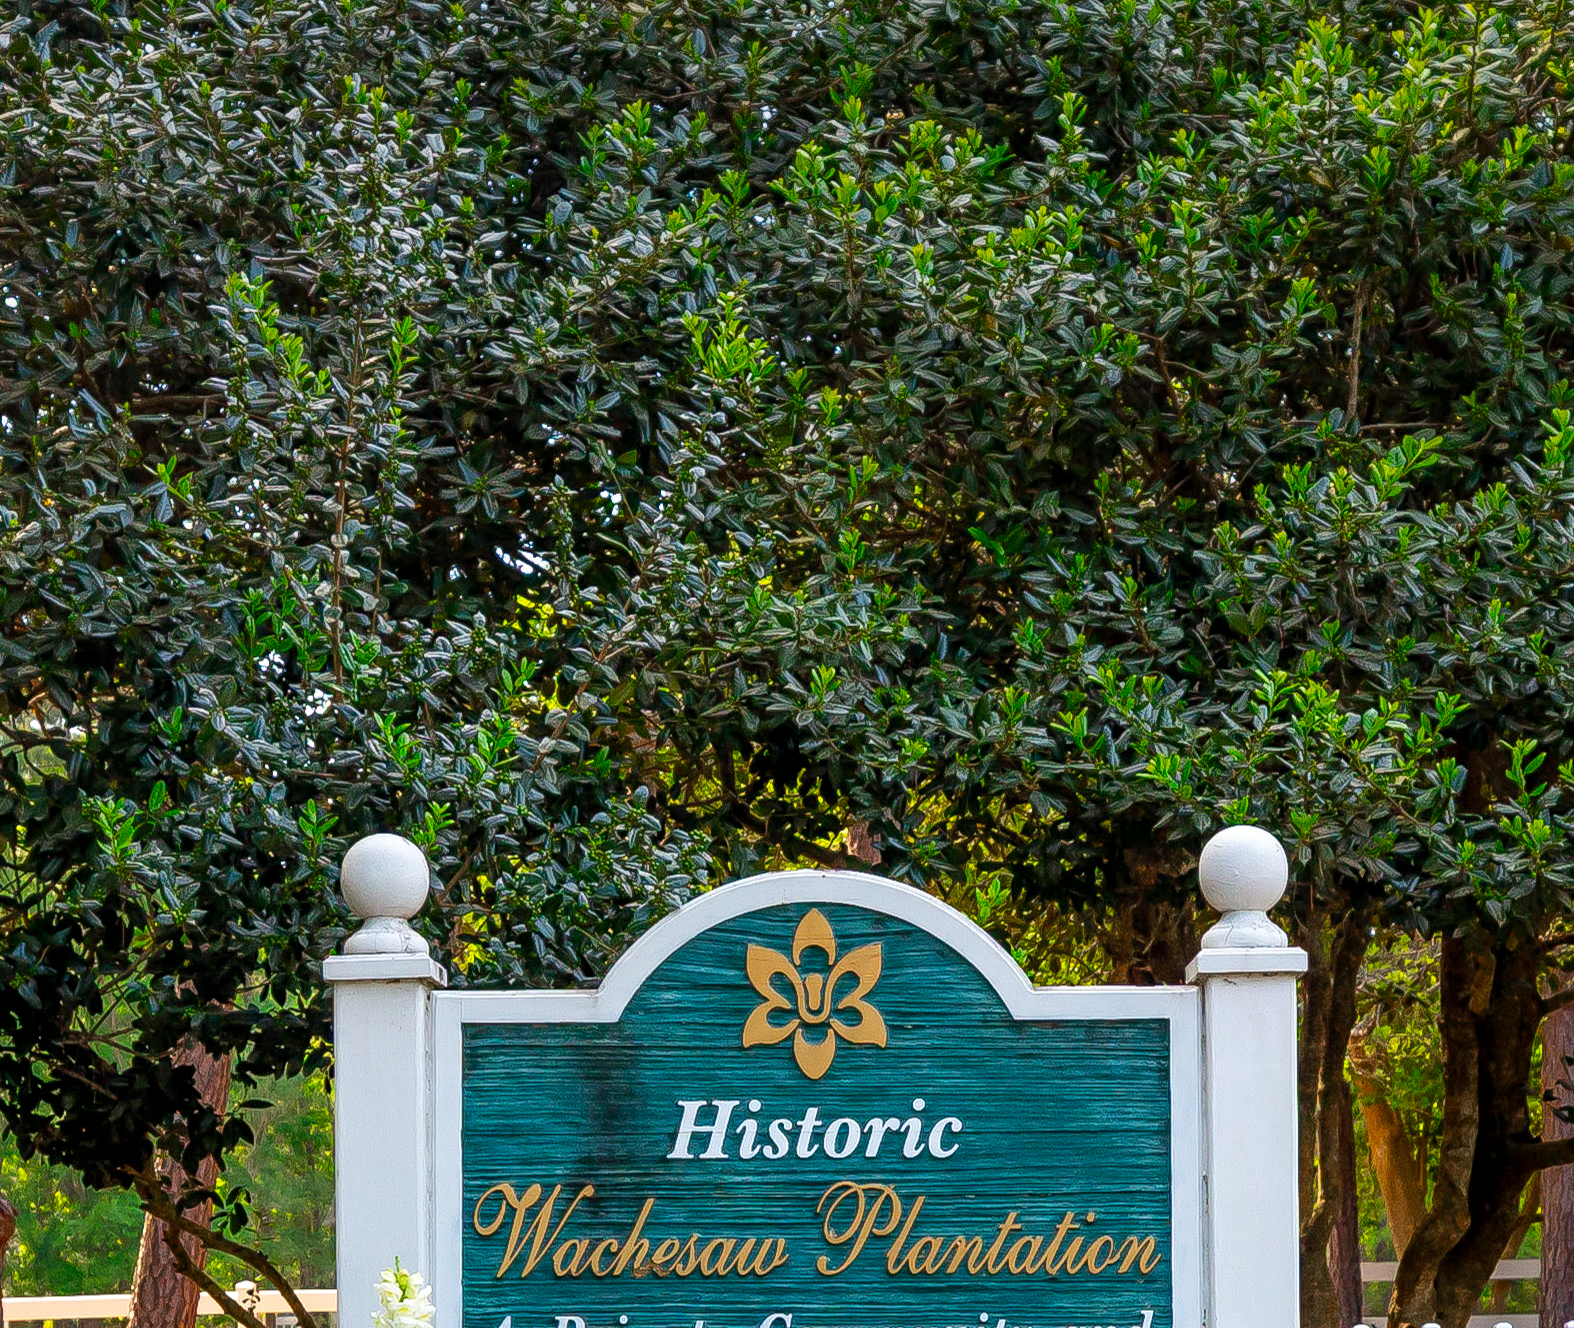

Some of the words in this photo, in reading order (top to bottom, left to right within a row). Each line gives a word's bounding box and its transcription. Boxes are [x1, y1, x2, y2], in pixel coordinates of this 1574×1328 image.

[667, 1098, 963, 1160] Historic
[473, 1183, 790, 1278] Wachesaw
[816, 1181, 1162, 1275] Plantation
